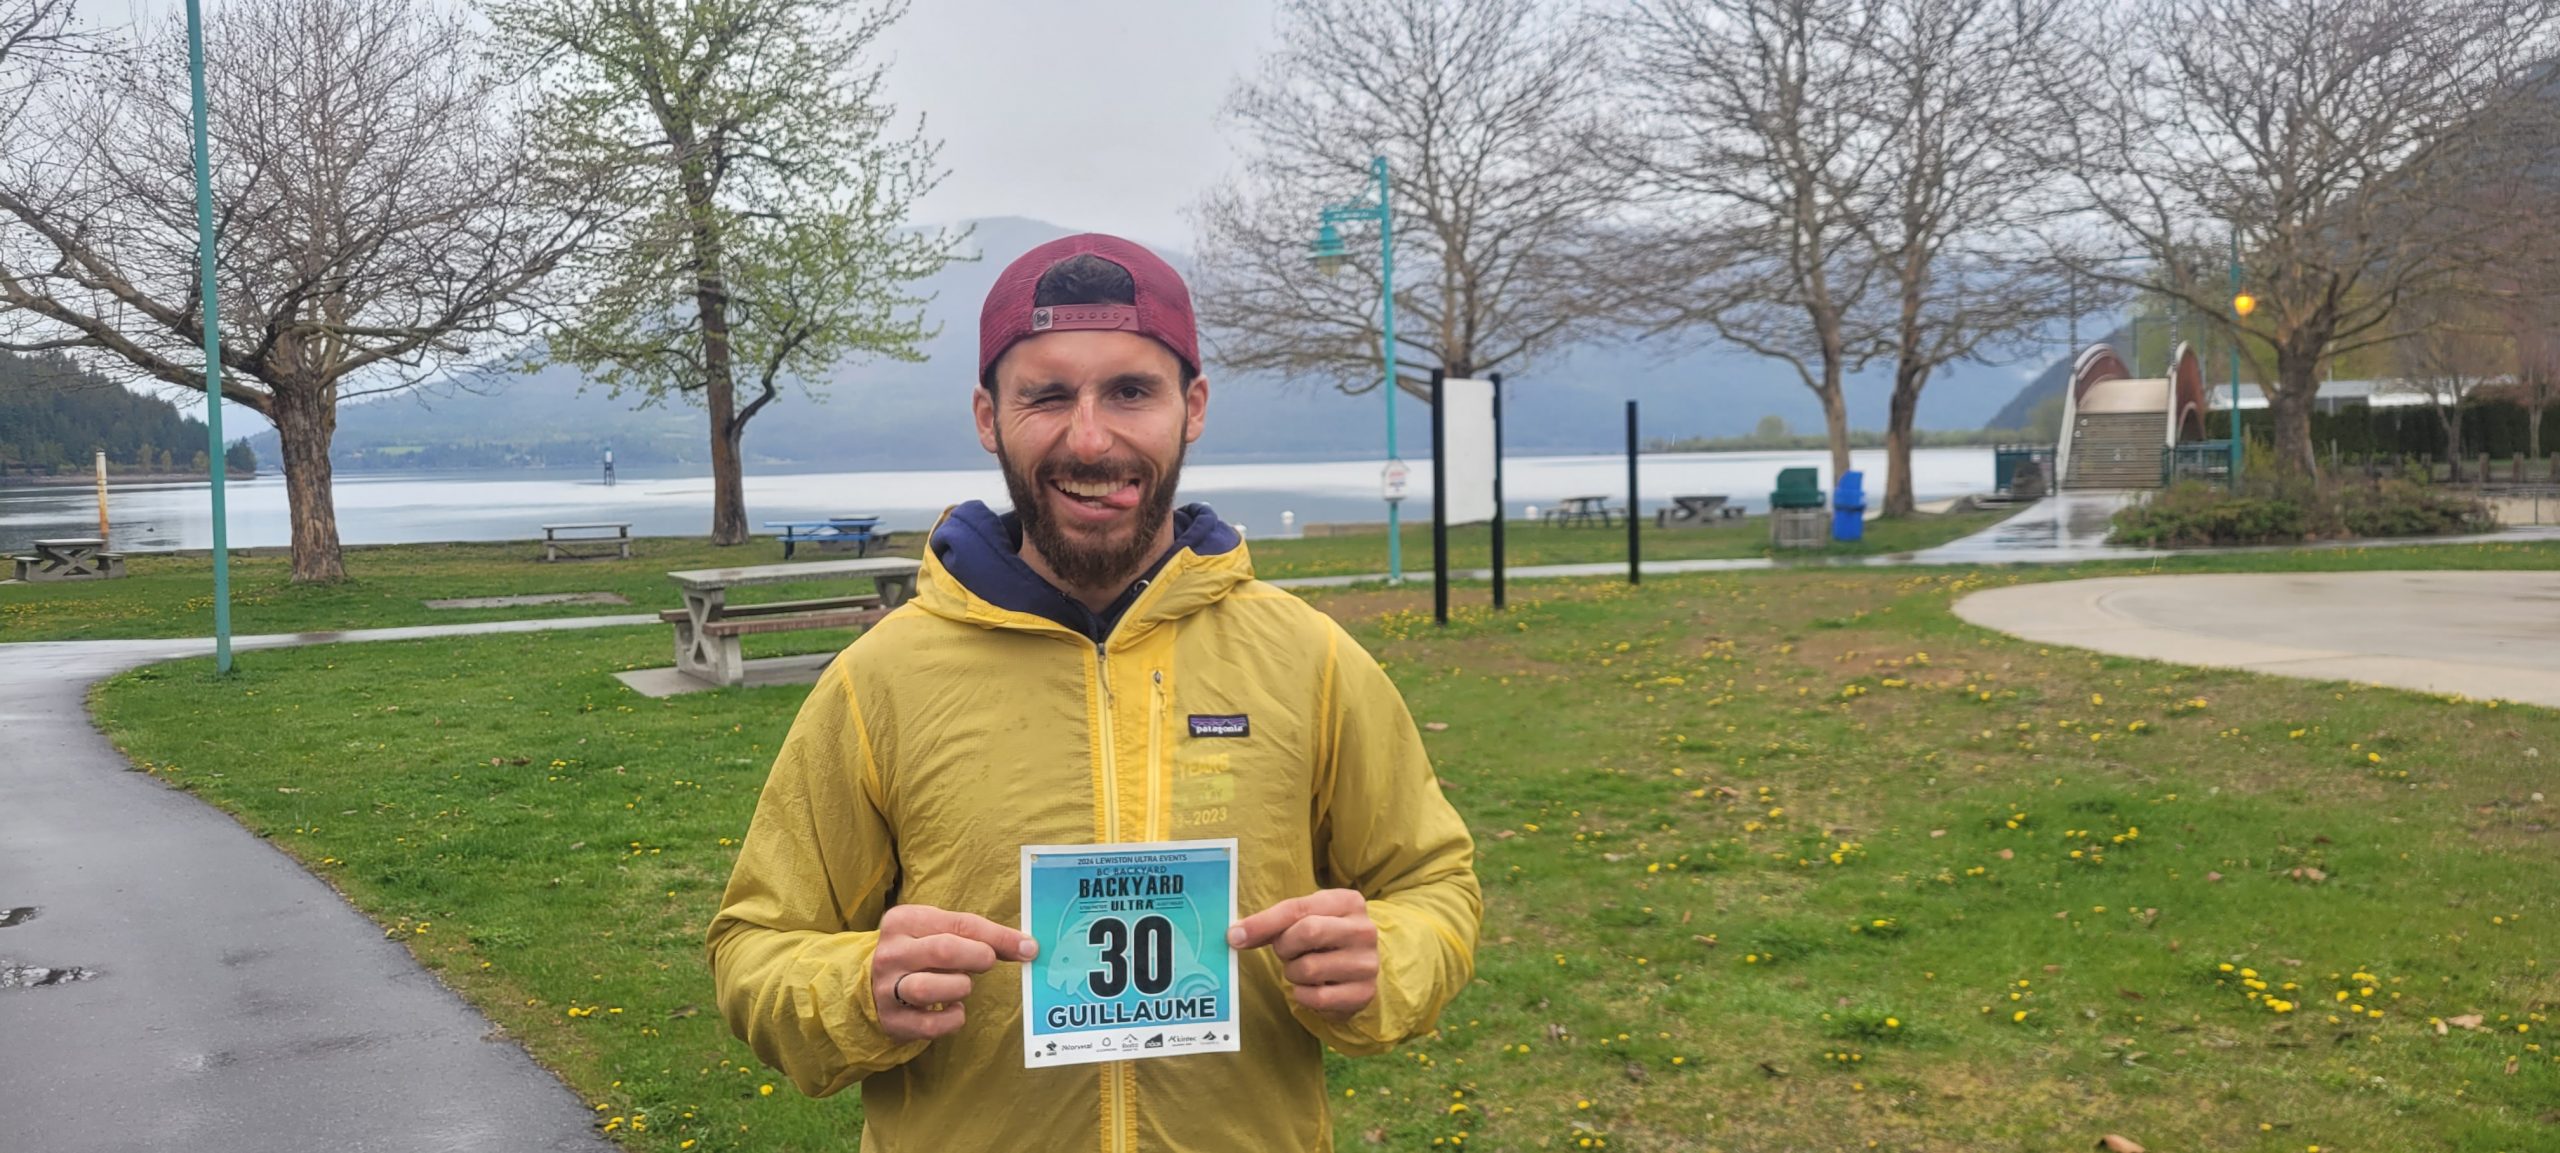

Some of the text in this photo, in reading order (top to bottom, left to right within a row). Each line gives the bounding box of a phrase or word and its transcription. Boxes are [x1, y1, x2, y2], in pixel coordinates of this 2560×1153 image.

[1196, 725, 1244, 735] patagonia
[1095, 856, 1134, 865] LEWISTON
[1135, 855, 1158, 863] ULTRA
[1159, 854, 1188, 862] EVENTS
[1096, 865, 1167, 876] BC BACKYARD
[1079, 874, 1184, 898] BACKYARD
[1110, 899, 1155, 912] ULTRA
[1088, 915, 1173, 998] 30
[1048, 997, 1216, 1028] GUILLAUME
